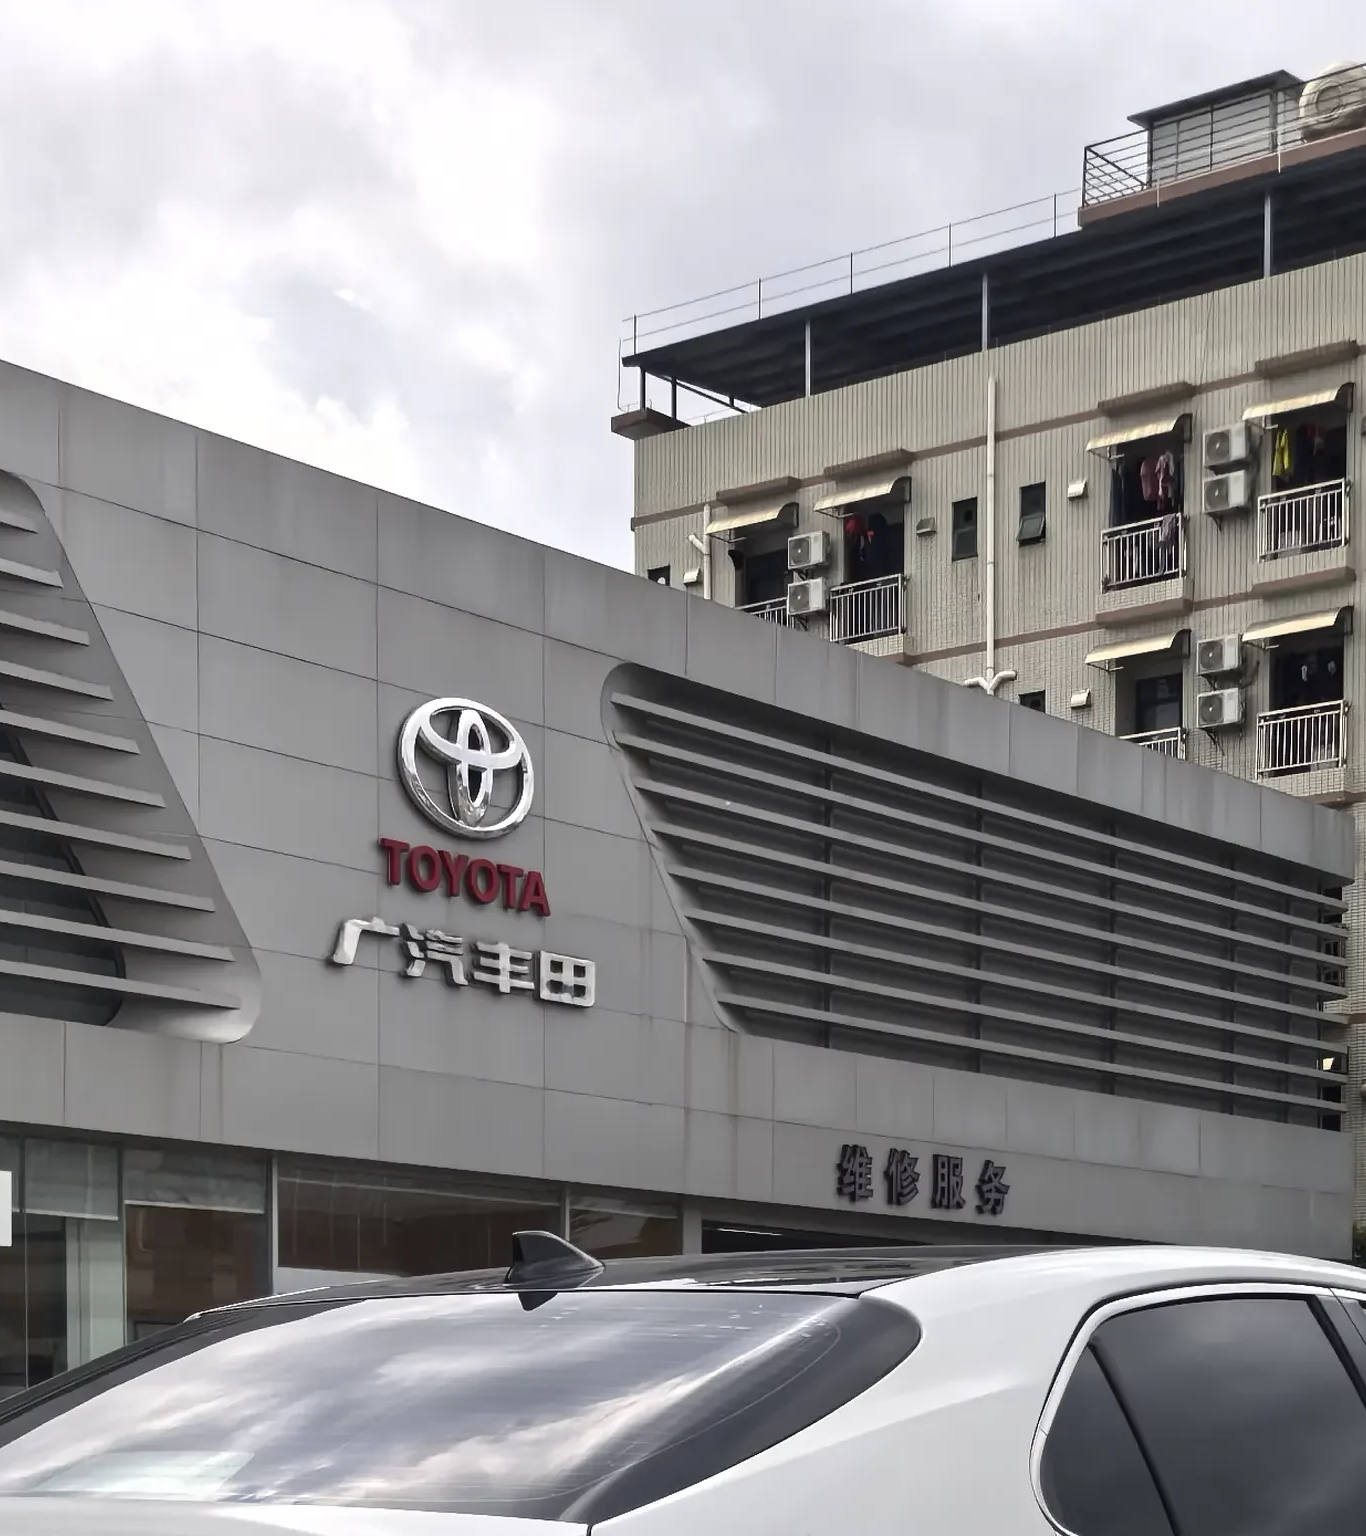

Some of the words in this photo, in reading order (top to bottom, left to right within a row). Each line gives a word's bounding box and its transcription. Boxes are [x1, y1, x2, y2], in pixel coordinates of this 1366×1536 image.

[379, 836, 551, 917] TOYOTA
[330, 916, 595, 1008] 广汽丰田
[836, 1143, 1011, 1217] 维修服务
